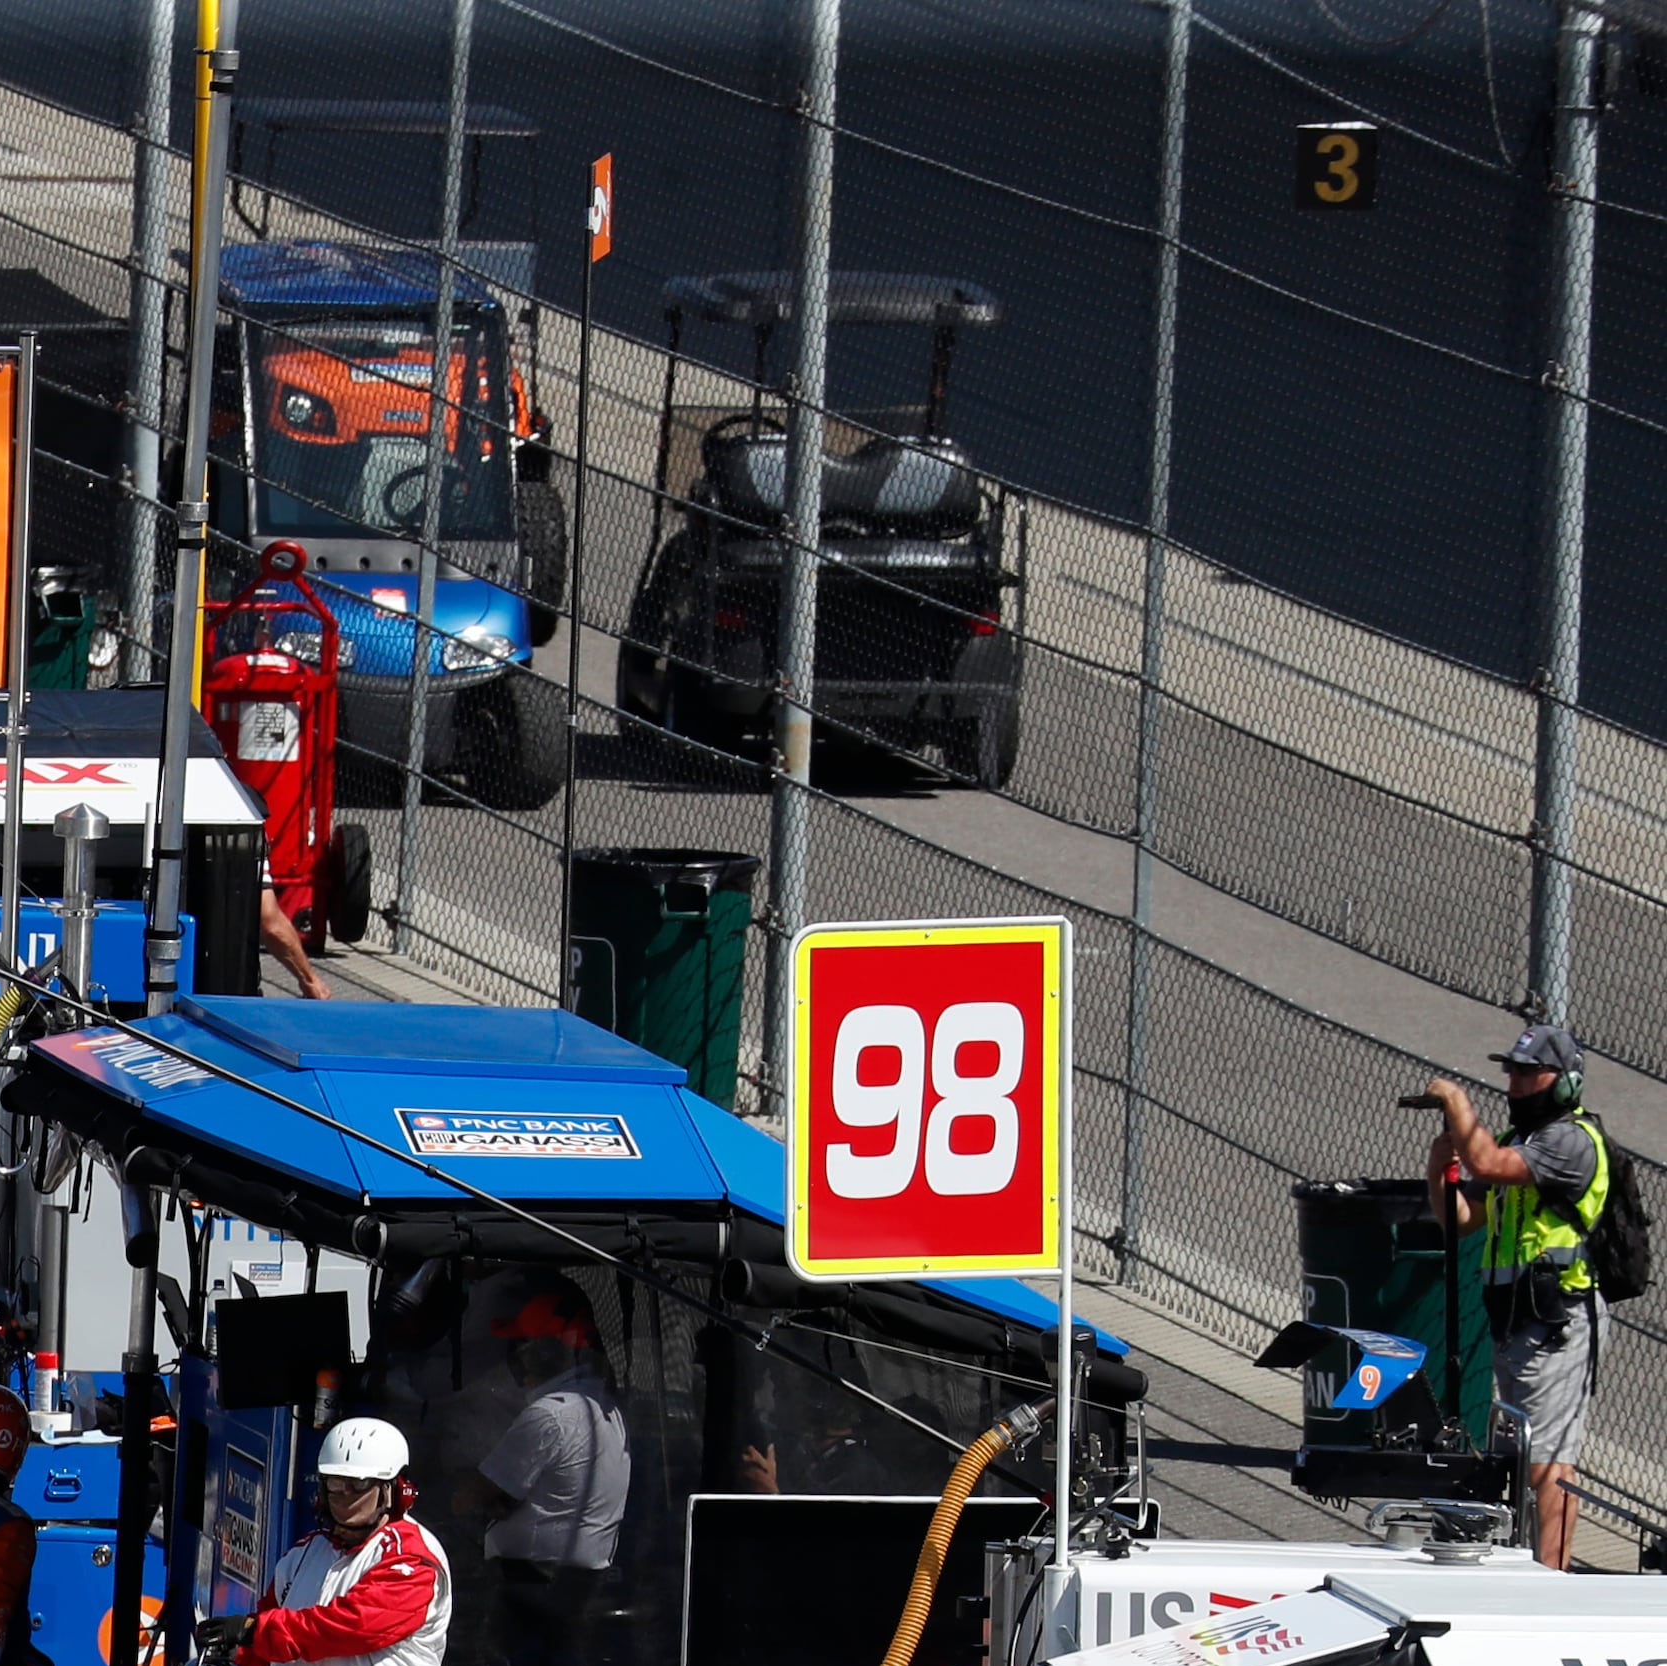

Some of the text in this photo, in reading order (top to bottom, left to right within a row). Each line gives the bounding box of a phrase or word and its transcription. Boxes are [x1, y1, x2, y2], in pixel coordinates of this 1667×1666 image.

[1314, 134, 1358, 204] 3
[825, 1001, 1025, 1200] 98
[419, 1132, 623, 1147] CHIP GANASSI
[448, 1117, 616, 1133] PNC BANK
[1358, 1364, 1381, 1401] 9
